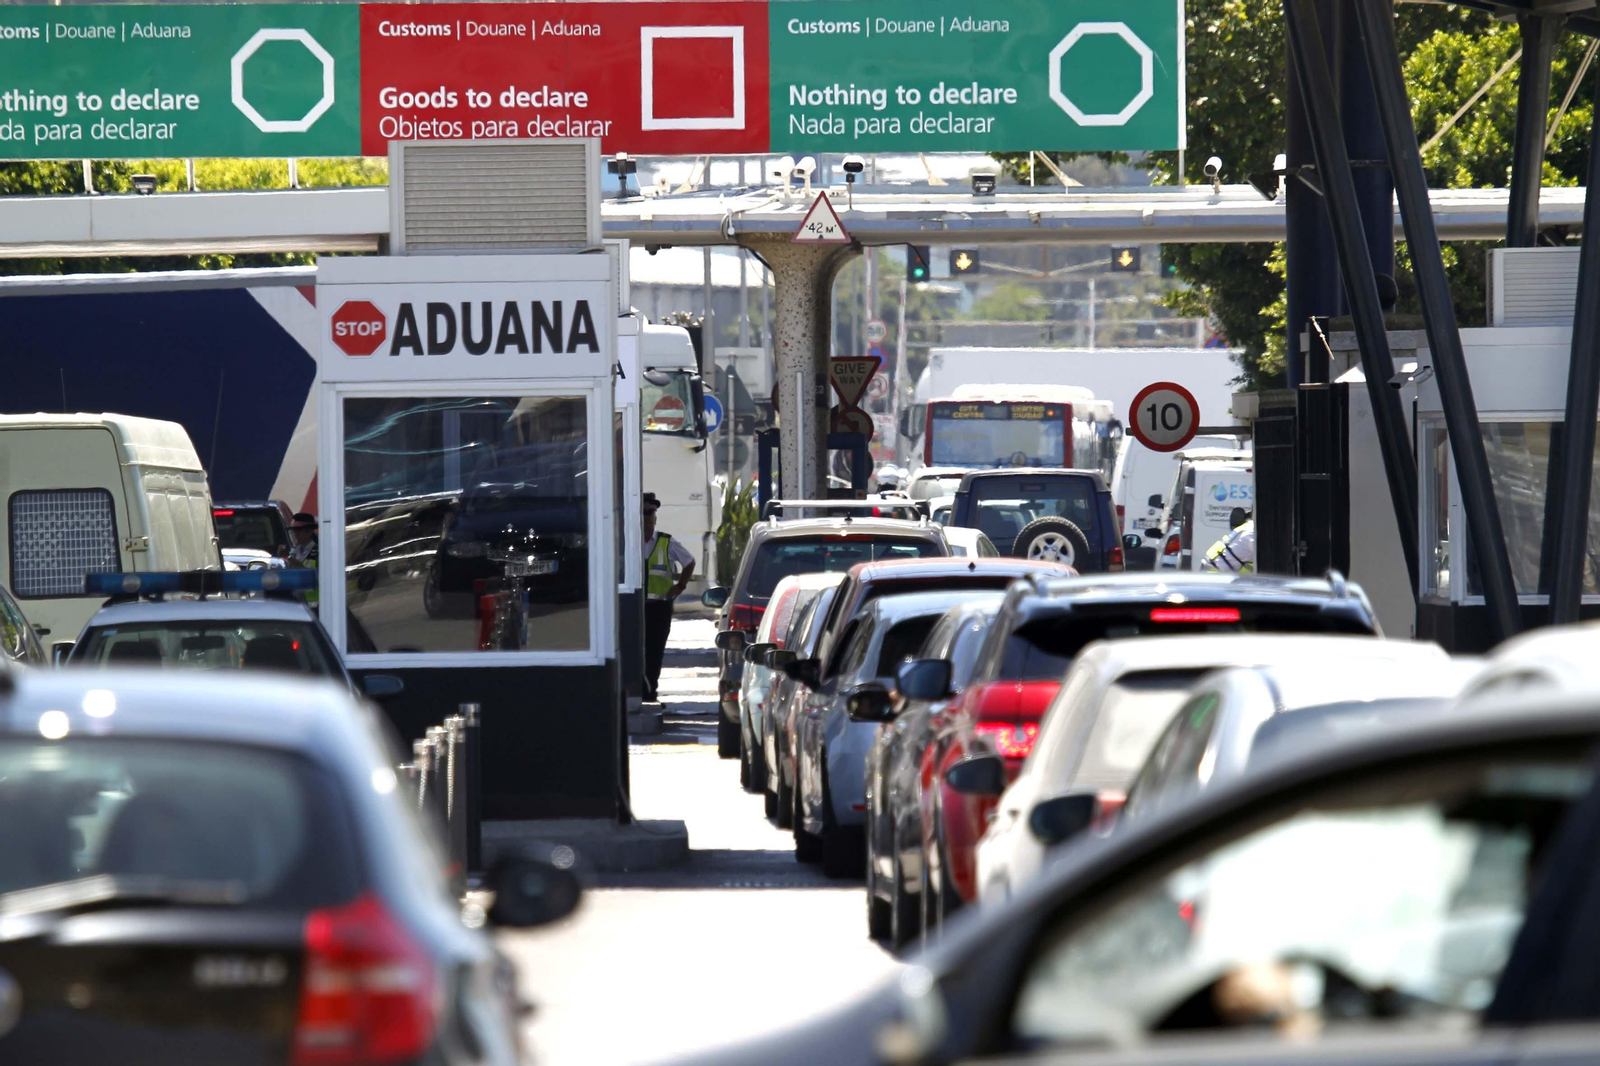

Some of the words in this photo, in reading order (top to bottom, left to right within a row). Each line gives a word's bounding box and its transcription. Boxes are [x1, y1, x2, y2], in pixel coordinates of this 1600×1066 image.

[55, 23, 116, 39] Douane
[130, 22, 192, 39] Aduana
[378, 21, 451, 37] Customs
[465, 21, 526, 37] Douane
[541, 20, 601, 37] Aduana
[787, 18, 861, 34] Customs
[875, 18, 935, 33] Douane
[949, 16, 1010, 33] Aduana
[75, 92, 102, 111] to
[111, 88, 200, 111] declare
[379, 86, 459, 109] Goods
[465, 88, 493, 108] to
[499, 85, 589, 108] declare
[789, 84, 888, 111] Nothing
[895, 86, 921, 105] to
[929, 82, 1018, 105] declare
[34, 123, 83, 146] para
[90, 117, 178, 140] declarar
[378, 115, 463, 140] Objetos
[471, 119, 519, 139] para
[527, 114, 613, 138] declarar
[789, 112, 846, 135] Nada
[854, 117, 902, 139] para
[909, 111, 996, 134] declarar
[335, 321, 383, 337] STOP
[389, 300, 601, 357] ADUANA
[834, 363, 867, 375] GIVE
[839, 376, 864, 386] WAY
[1146, 402, 1183, 432] 10
